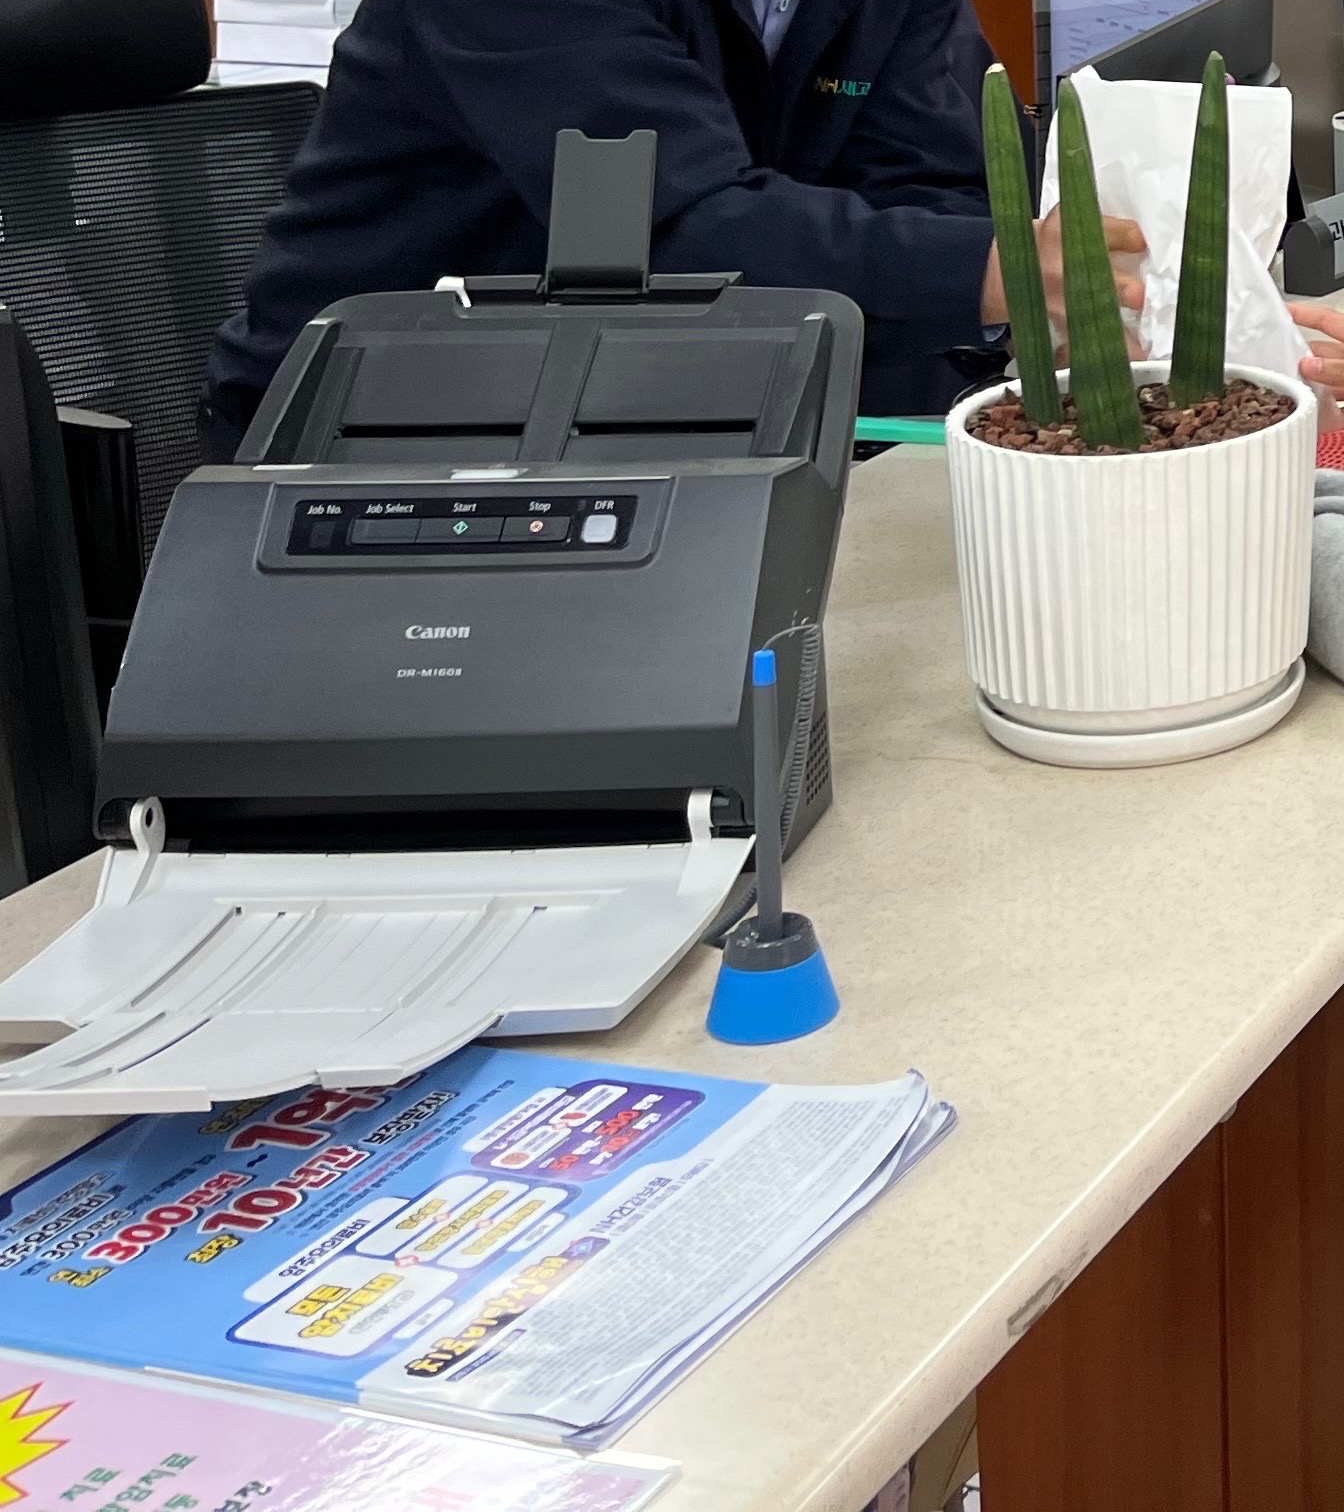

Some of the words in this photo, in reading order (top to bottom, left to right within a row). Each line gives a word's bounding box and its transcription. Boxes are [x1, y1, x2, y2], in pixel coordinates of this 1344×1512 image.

[307, 505, 325, 515] Job
[326, 505, 342, 515] No.
[366, 504, 383, 514] Job
[385, 503, 414, 514] Select
[453, 502, 476, 513] Start
[529, 501, 551, 513] Stop
[594, 500, 614, 511] DFR
[405, 625, 470, 639] Canon
[197, 1145, 371, 1235] 10년간
